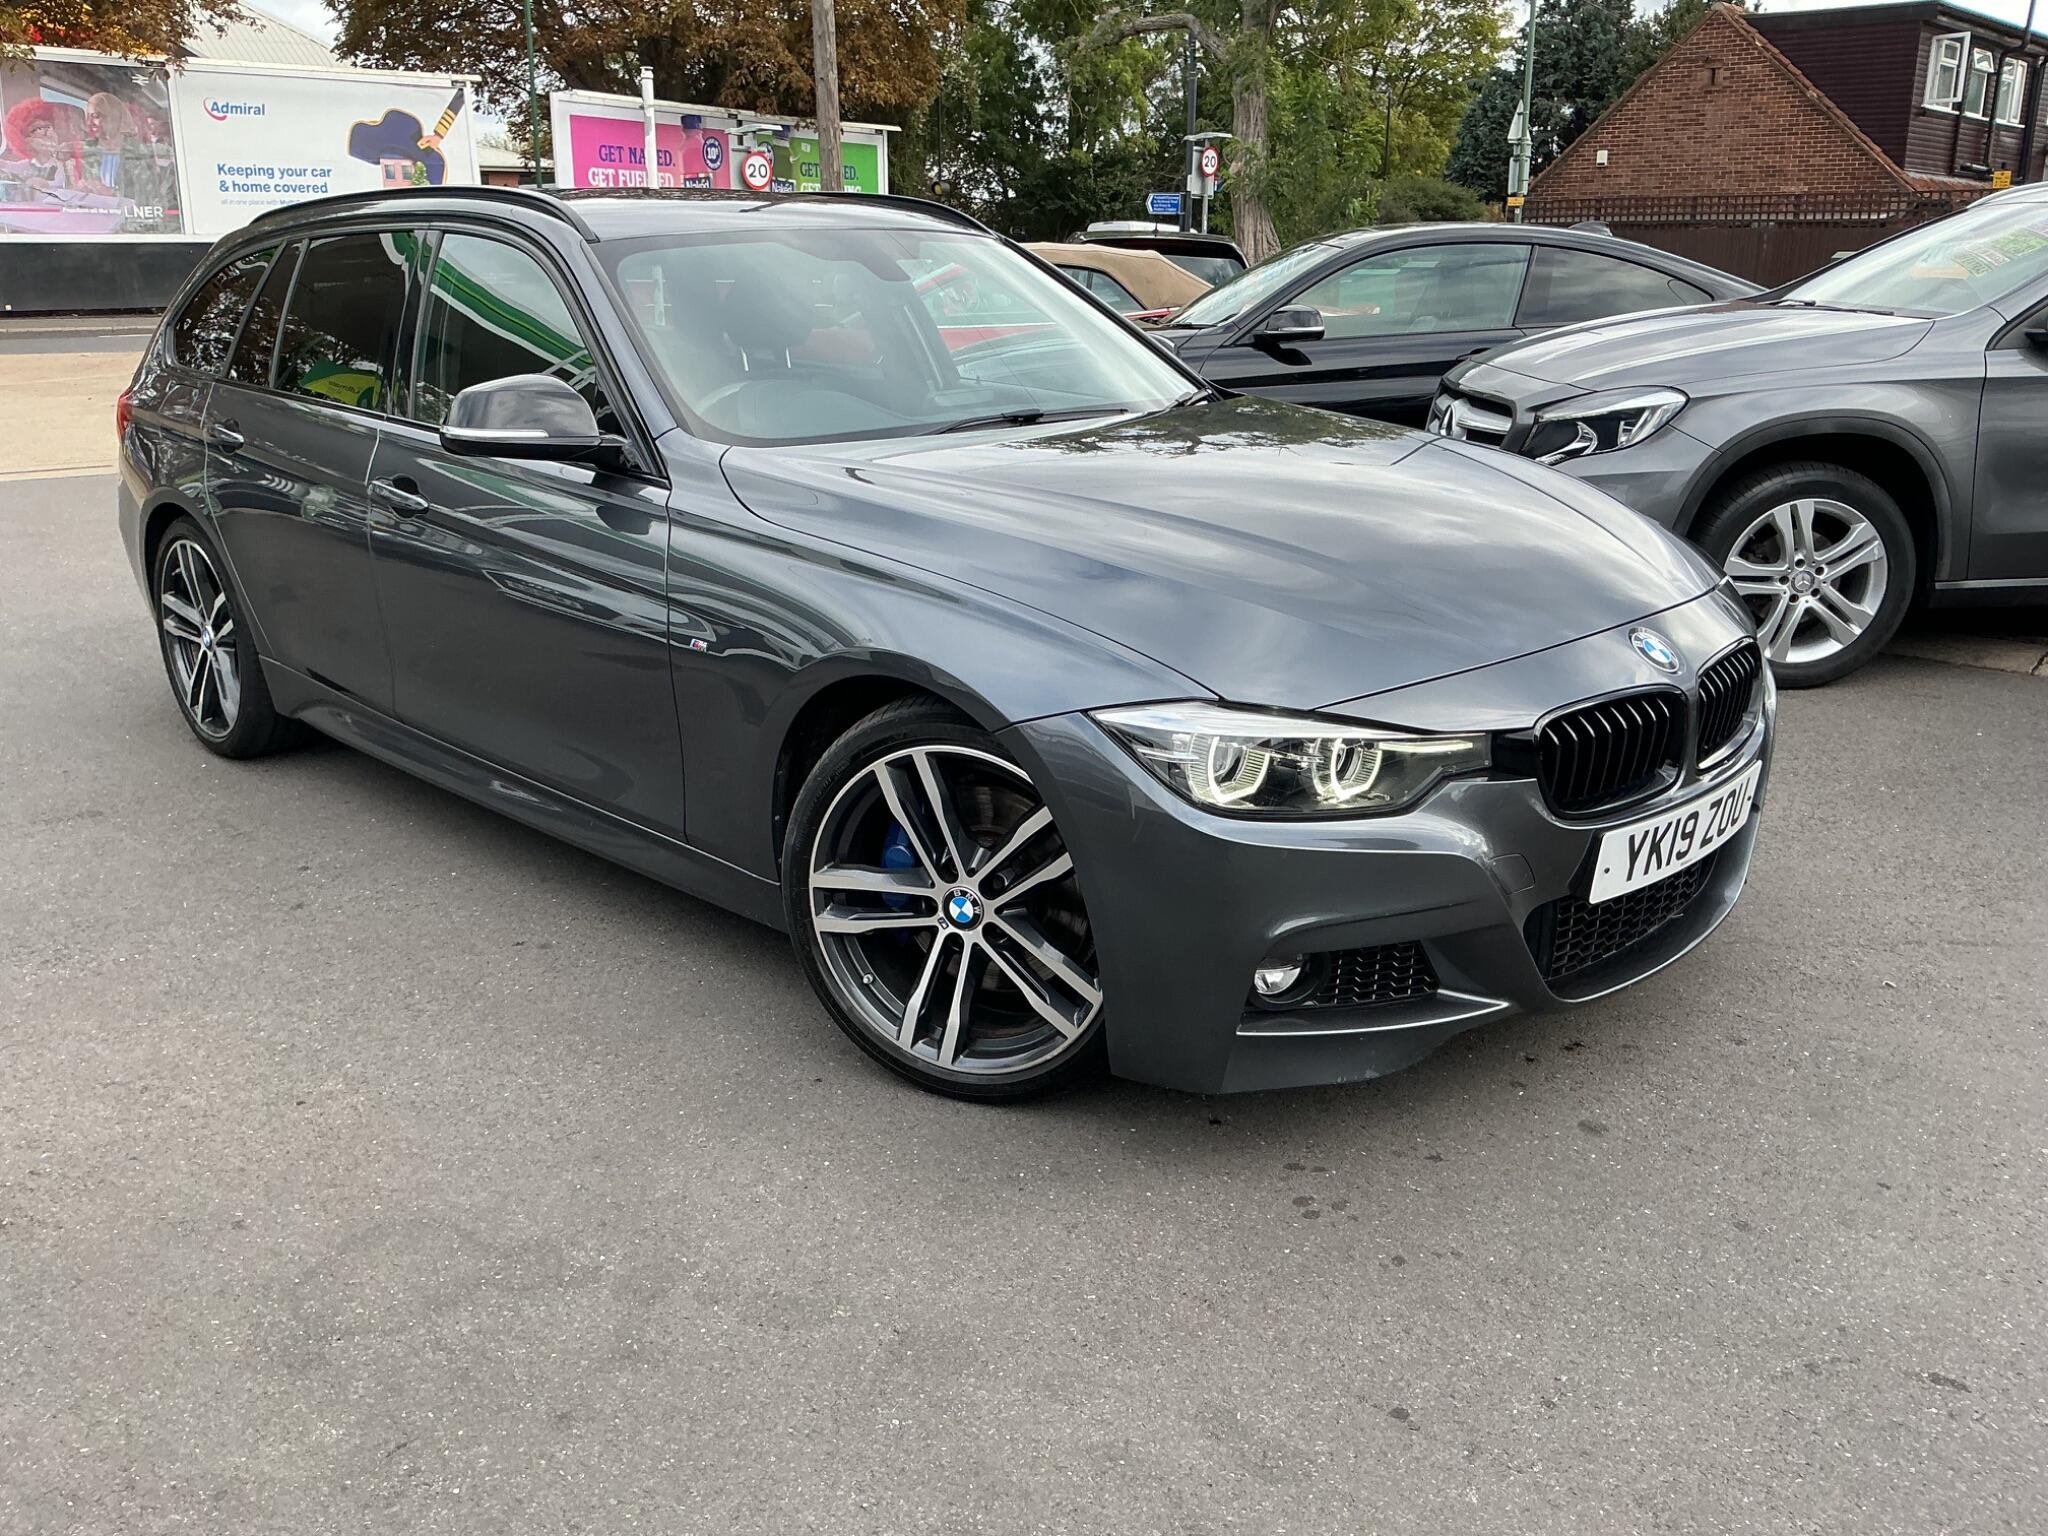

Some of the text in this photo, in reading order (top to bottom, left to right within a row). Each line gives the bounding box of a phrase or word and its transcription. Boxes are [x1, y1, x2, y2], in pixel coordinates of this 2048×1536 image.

[210, 101, 266, 116] Admiral
[599, 144, 676, 167] GET NAED.
[1204, 155, 1216, 168] 20
[217, 163, 332, 180] Keeping your car
[587, 166, 616, 187] GET
[747, 163, 768, 178] 20
[800, 161, 820, 178] GET
[219, 180, 329, 193] & home covered
[124, 206, 164, 219] LNER
[1626, 776, 1751, 883] YK19 ZOU
[953, 889, 982, 915] BMW
